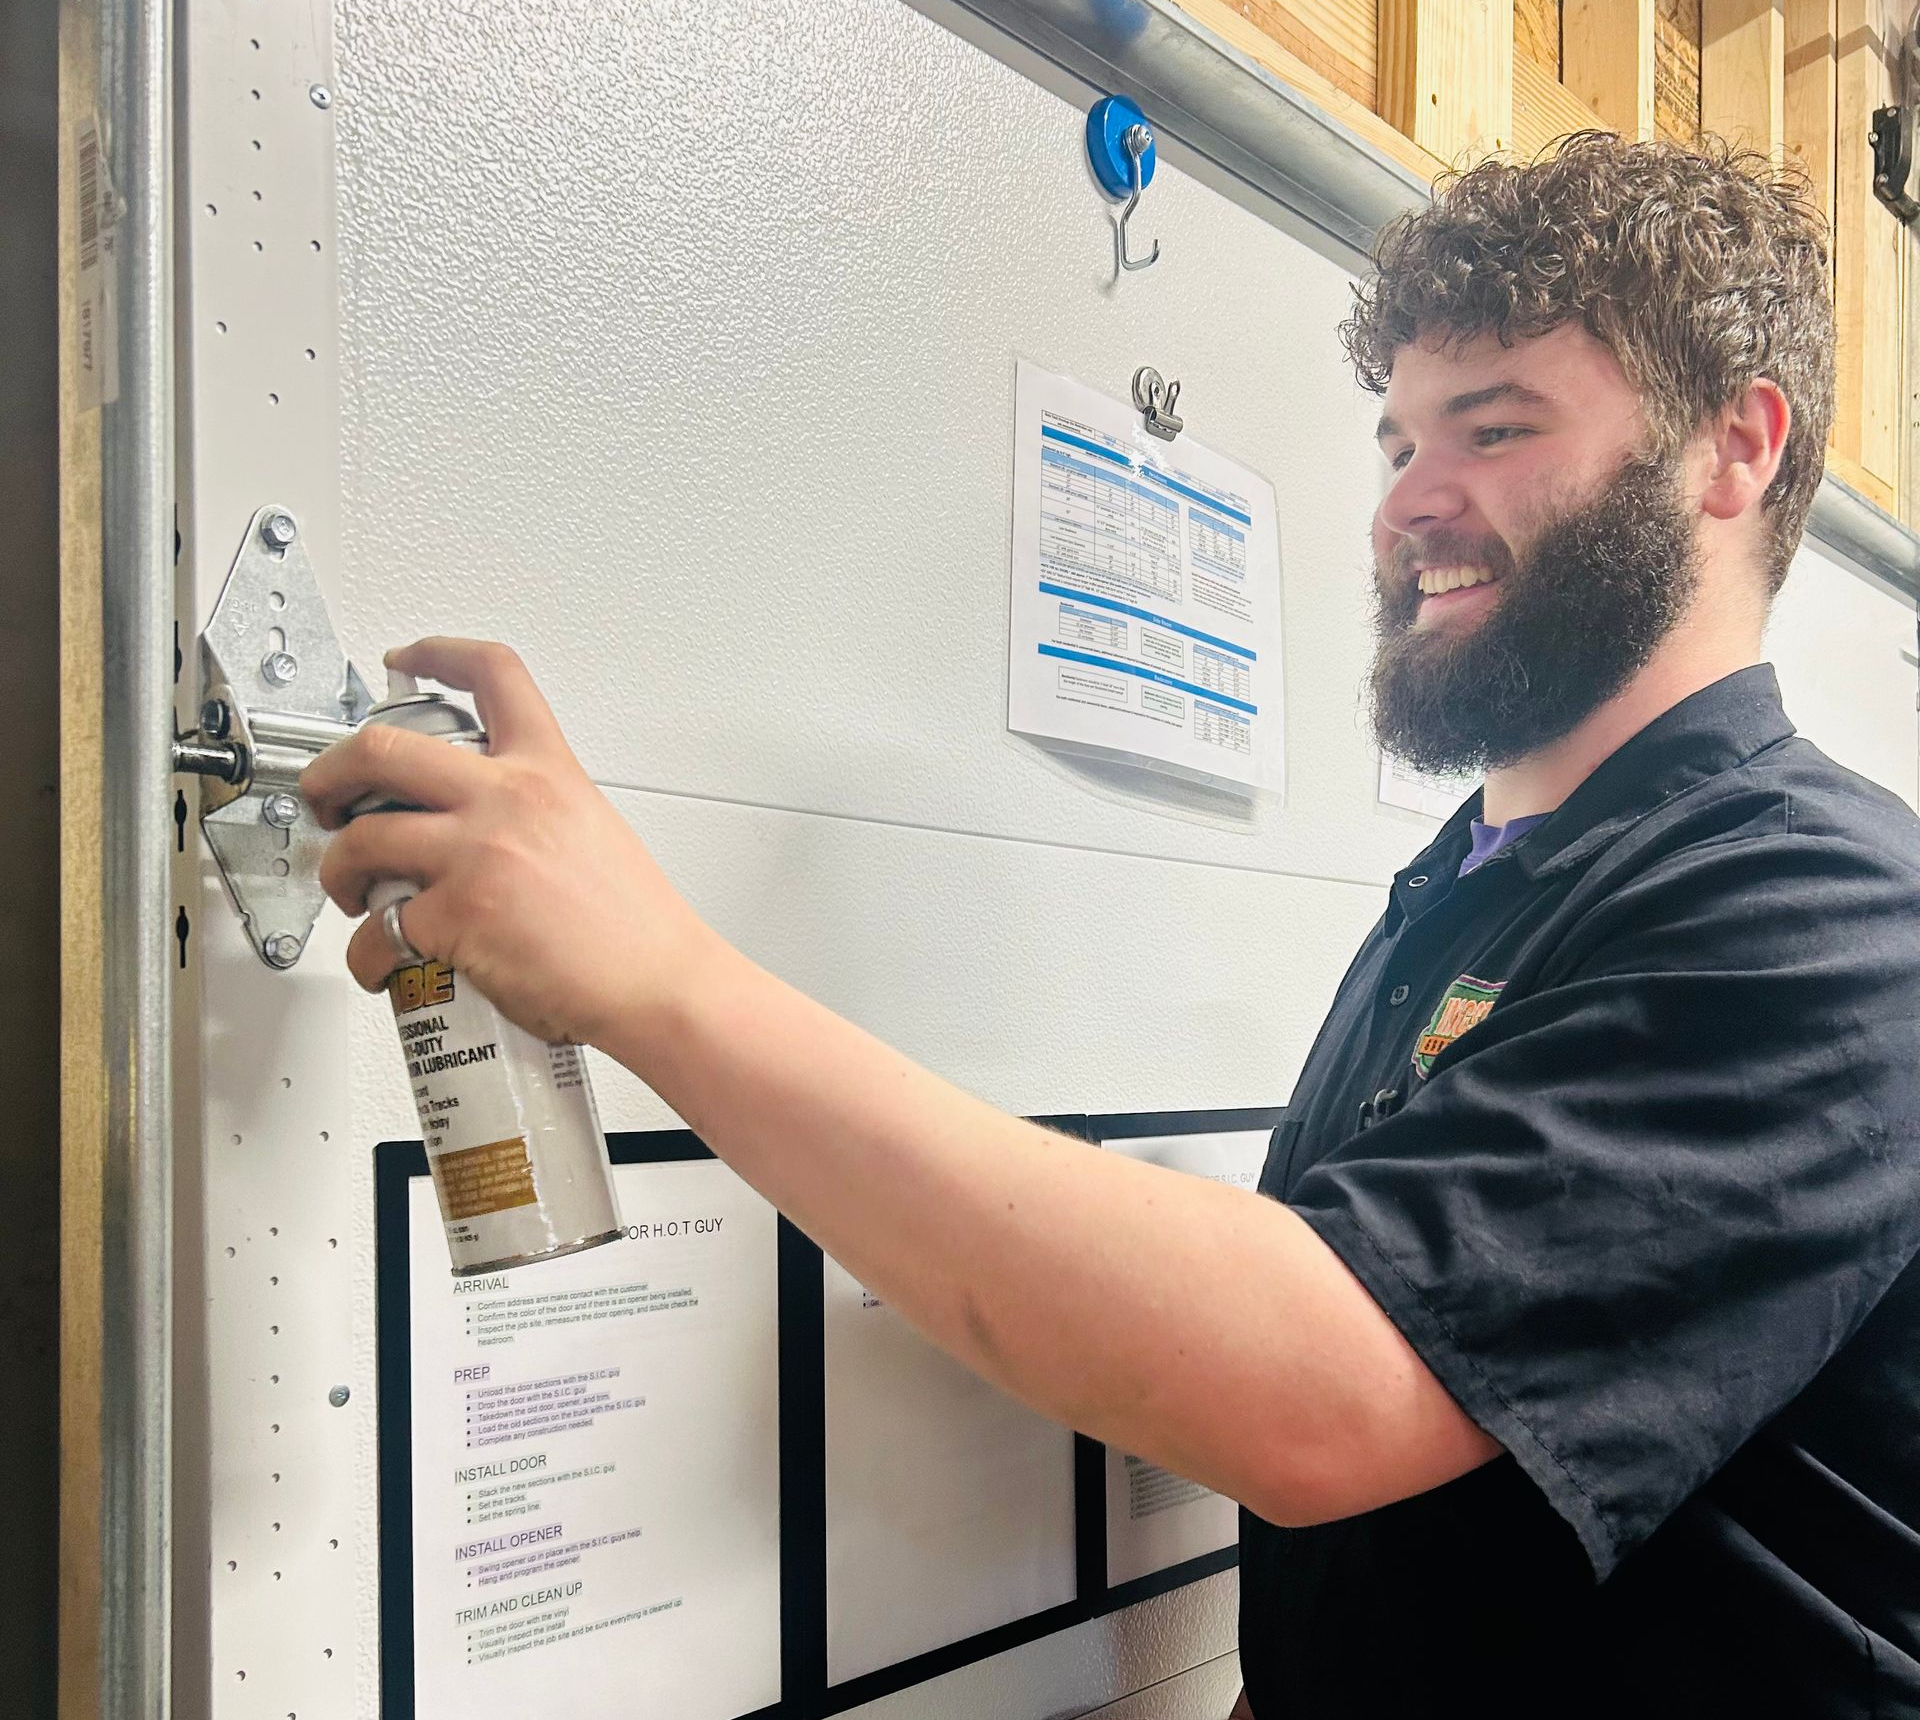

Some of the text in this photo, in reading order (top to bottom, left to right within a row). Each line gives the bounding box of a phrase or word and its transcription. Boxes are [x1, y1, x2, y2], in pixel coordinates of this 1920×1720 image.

[389, 958, 455, 1016] BE
[400, 1016, 449, 1040] SSIONAL
[422, 1043, 496, 1074] LUBRICANT
[1240, 1173, 1255, 1183] GUY
[628, 1224, 649, 1240] OR
[695, 1218, 723, 1233] GUY
[453, 1277, 509, 1294] ARRIVAL
[478, 1301, 505, 1311] Confirm
[507, 1297, 534, 1307] address
[536, 1295, 548, 1303] and
[550, 1292, 568, 1301] make
[570, 1290, 593, 1299] contact
[594, 1288, 607, 1296] with
[608, 1286, 618, 1294] the
[478, 1313, 505, 1323] Confirm
[507, 1311, 518, 1319] the
[520, 1308, 536, 1317] color
[538, 1306, 544, 1315] of
[559, 1303, 573, 1312] door
[575, 1302, 587, 1310] and
[594, 1299, 610, 1307] there
[628, 1294, 648, 1304] opener
[650, 1292, 666, 1301] being
[478, 1325, 503, 1335] Inspect
[506, 1323, 516, 1331] the
[518, 1320, 528, 1331] job
[582, 1313, 592, 1321] the
[593, 1311, 607, 1319] door
[650, 1303, 670, 1312] double
[671, 1300, 688, 1309] check
[689, 1298, 698, 1306] the
[454, 1366, 490, 1382] PREP
[478, 1388, 503, 1398] Unload
[505, 1386, 516, 1394] the
[518, 1384, 533, 1392] door
[534, 1380, 561, 1389] sections
[563, 1376, 576, 1384] with
[578, 1374, 588, 1382] the
[478, 1402, 495, 1411] Drop
[497, 1399, 508, 1407] the
[510, 1396, 525, 1405] door
[527, 1394, 540, 1402] with
[515, 1408, 525, 1416] the
[583, 1396, 595, 1404] and
[478, 1425, 496, 1434] Load
[510, 1420, 520, 1428] old
[523, 1415, 549, 1426] sections
[561, 1411, 572, 1419] the
[573, 1408, 589, 1417] truck
[478, 1434, 512, 1446] Complete
[513, 1432, 526, 1440] any
[454, 1454, 547, 1483] INSTALL DOOR
[479, 1488, 498, 1498] Stack
[500, 1486, 510, 1494] the
[512, 1483, 526, 1491] new
[528, 1477, 555, 1488] sections
[558, 1473, 571, 1481] with
[479, 1502, 491, 1510] Set
[479, 1513, 491, 1522] Set
[505, 1506, 526, 1517] spring
[455, 1525, 563, 1561] INSTALL OPENER
[478, 1563, 500, 1574] Swing
[502, 1557, 526, 1568] opener
[546, 1548, 564, 1559] place
[565, 1544, 579, 1552] with
[580, 1542, 590, 1550] the
[478, 1576, 498, 1587] Hang
[500, 1572, 512, 1581] and
[514, 1565, 542, 1578] program
[456, 1582, 583, 1625] TRIM AND CLEAN UP
[479, 1649, 506, 1662] Visually
[507, 1642, 532, 1654] inspect
[534, 1639, 544, 1647] the
[546, 1636, 556, 1645] job
[572, 1628, 584, 1637] and
[585, 1625, 594, 1633] be
[610, 1611, 641, 1626] everything
[480, 1629, 494, 1638] Trim
[496, 1625, 507, 1634] the
[509, 1621, 525, 1631] door
[527, 1616, 540, 1625] with
[542, 1613, 552, 1621] the
[479, 1637, 505, 1650] Visually
[507, 1630, 532, 1642] inspect
[534, 1627, 544, 1636] the
